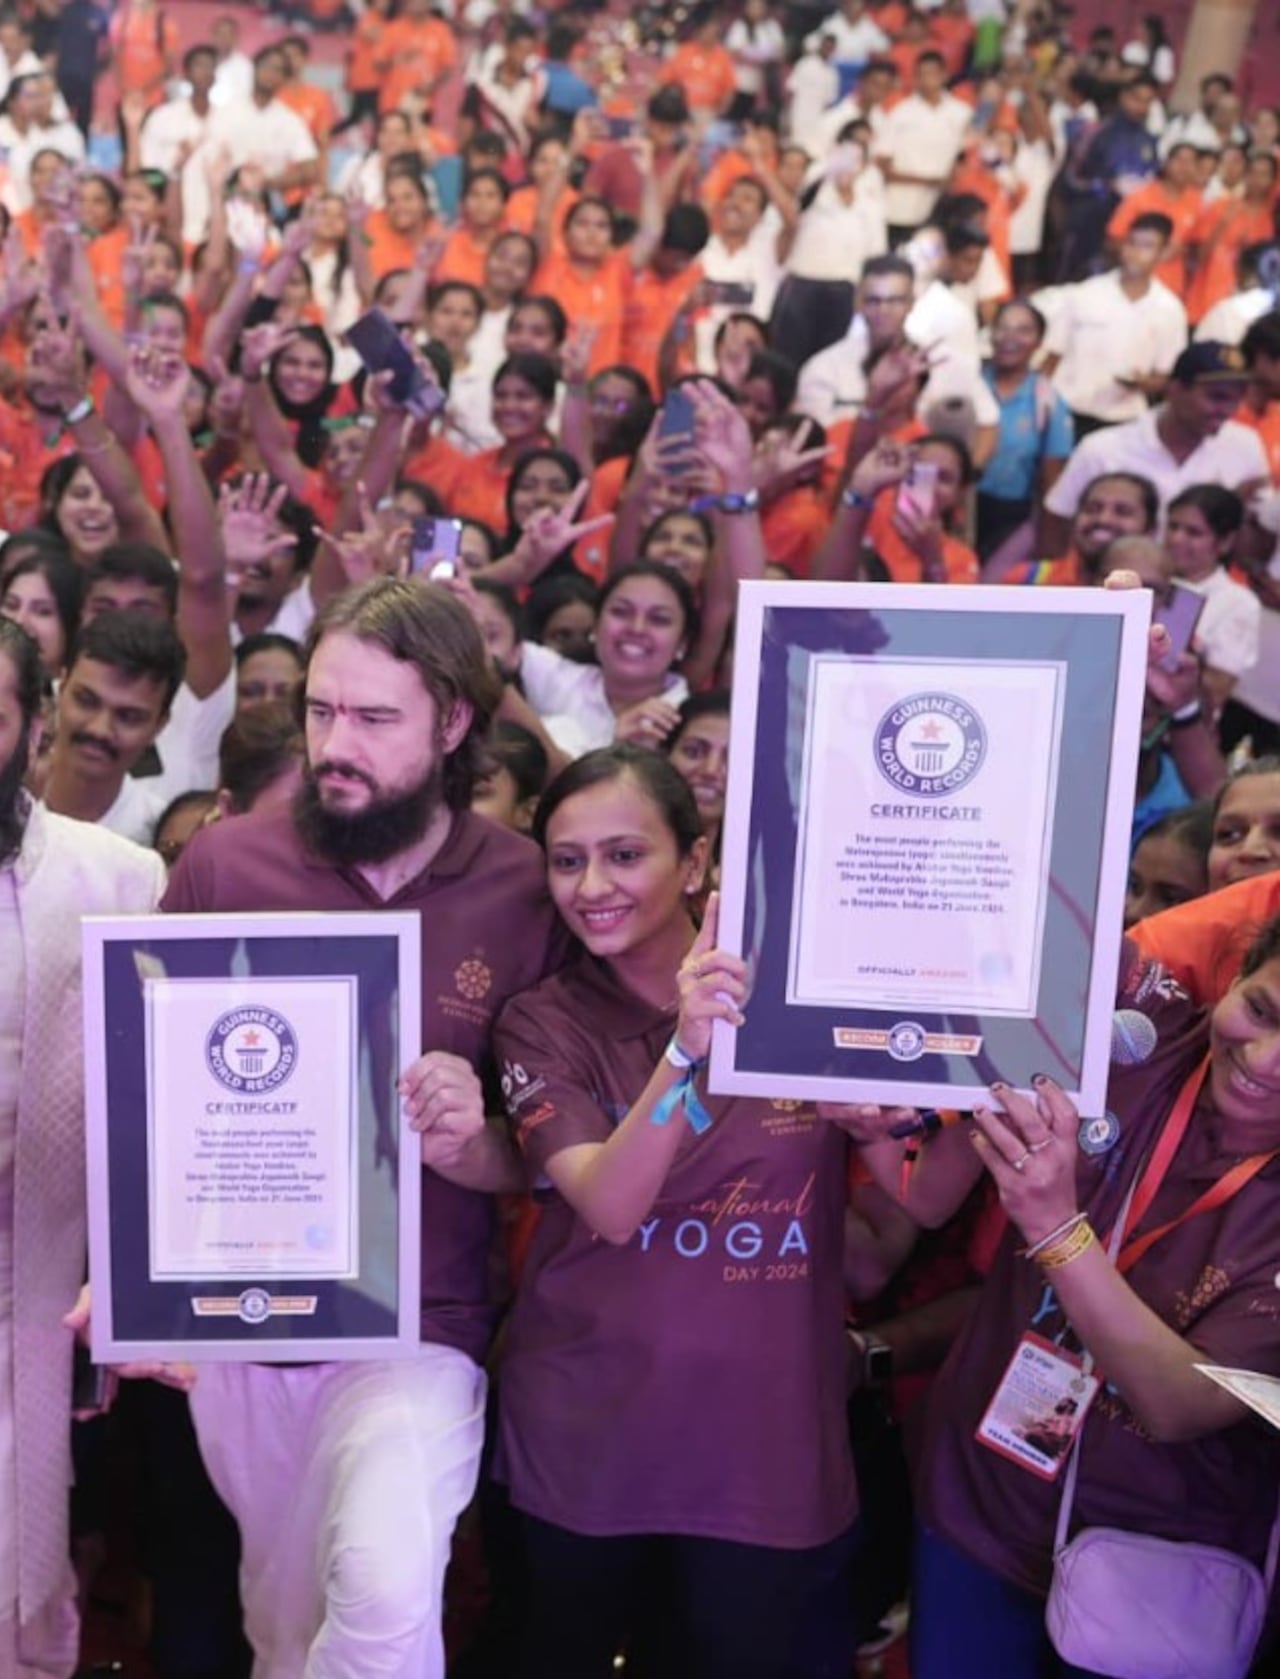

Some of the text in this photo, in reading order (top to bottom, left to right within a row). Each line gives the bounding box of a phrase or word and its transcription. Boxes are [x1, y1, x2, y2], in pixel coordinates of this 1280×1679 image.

[891, 698, 973, 727] GUINNESS
[880, 736, 981, 792] WORLD RECORDS
[870, 803, 983, 821] CERTIFICATE
[858, 965, 917, 976] OFFICIALLY
[218, 1010, 286, 1035] GUINNESS
[210, 1044, 294, 1091] WORLD RECORDS
[205, 1101, 298, 1117] CERTIFICATE
[690, 1170, 817, 1227] ational
[639, 1217, 809, 1259] YOGA
[723, 1262, 809, 1282] DAY 2024
